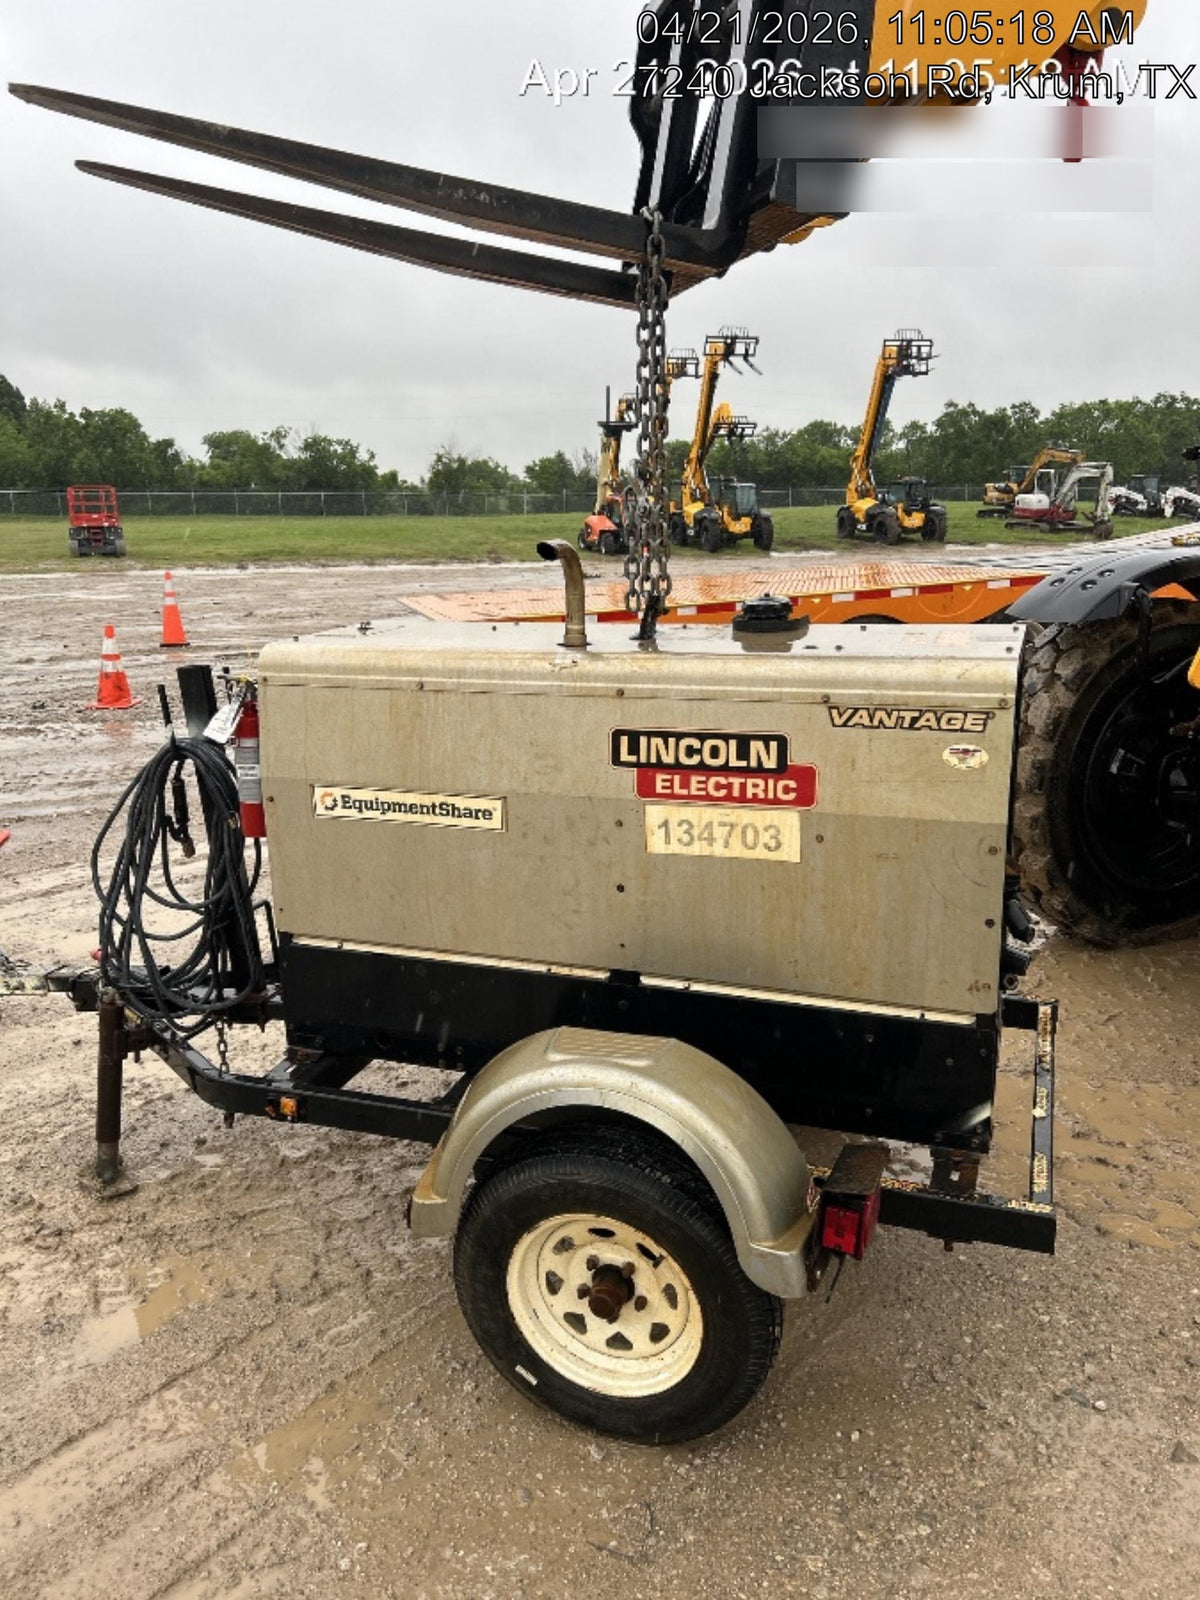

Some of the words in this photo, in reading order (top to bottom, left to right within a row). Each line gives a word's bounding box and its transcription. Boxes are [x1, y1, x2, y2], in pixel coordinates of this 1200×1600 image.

[829, 706, 987, 732] VANTAGE
[618, 734, 779, 769] LINCOLN
[654, 773, 798, 801] ELECTRIC
[340, 794, 493, 820] EquipmentShare
[657, 818, 783, 853] 134703
